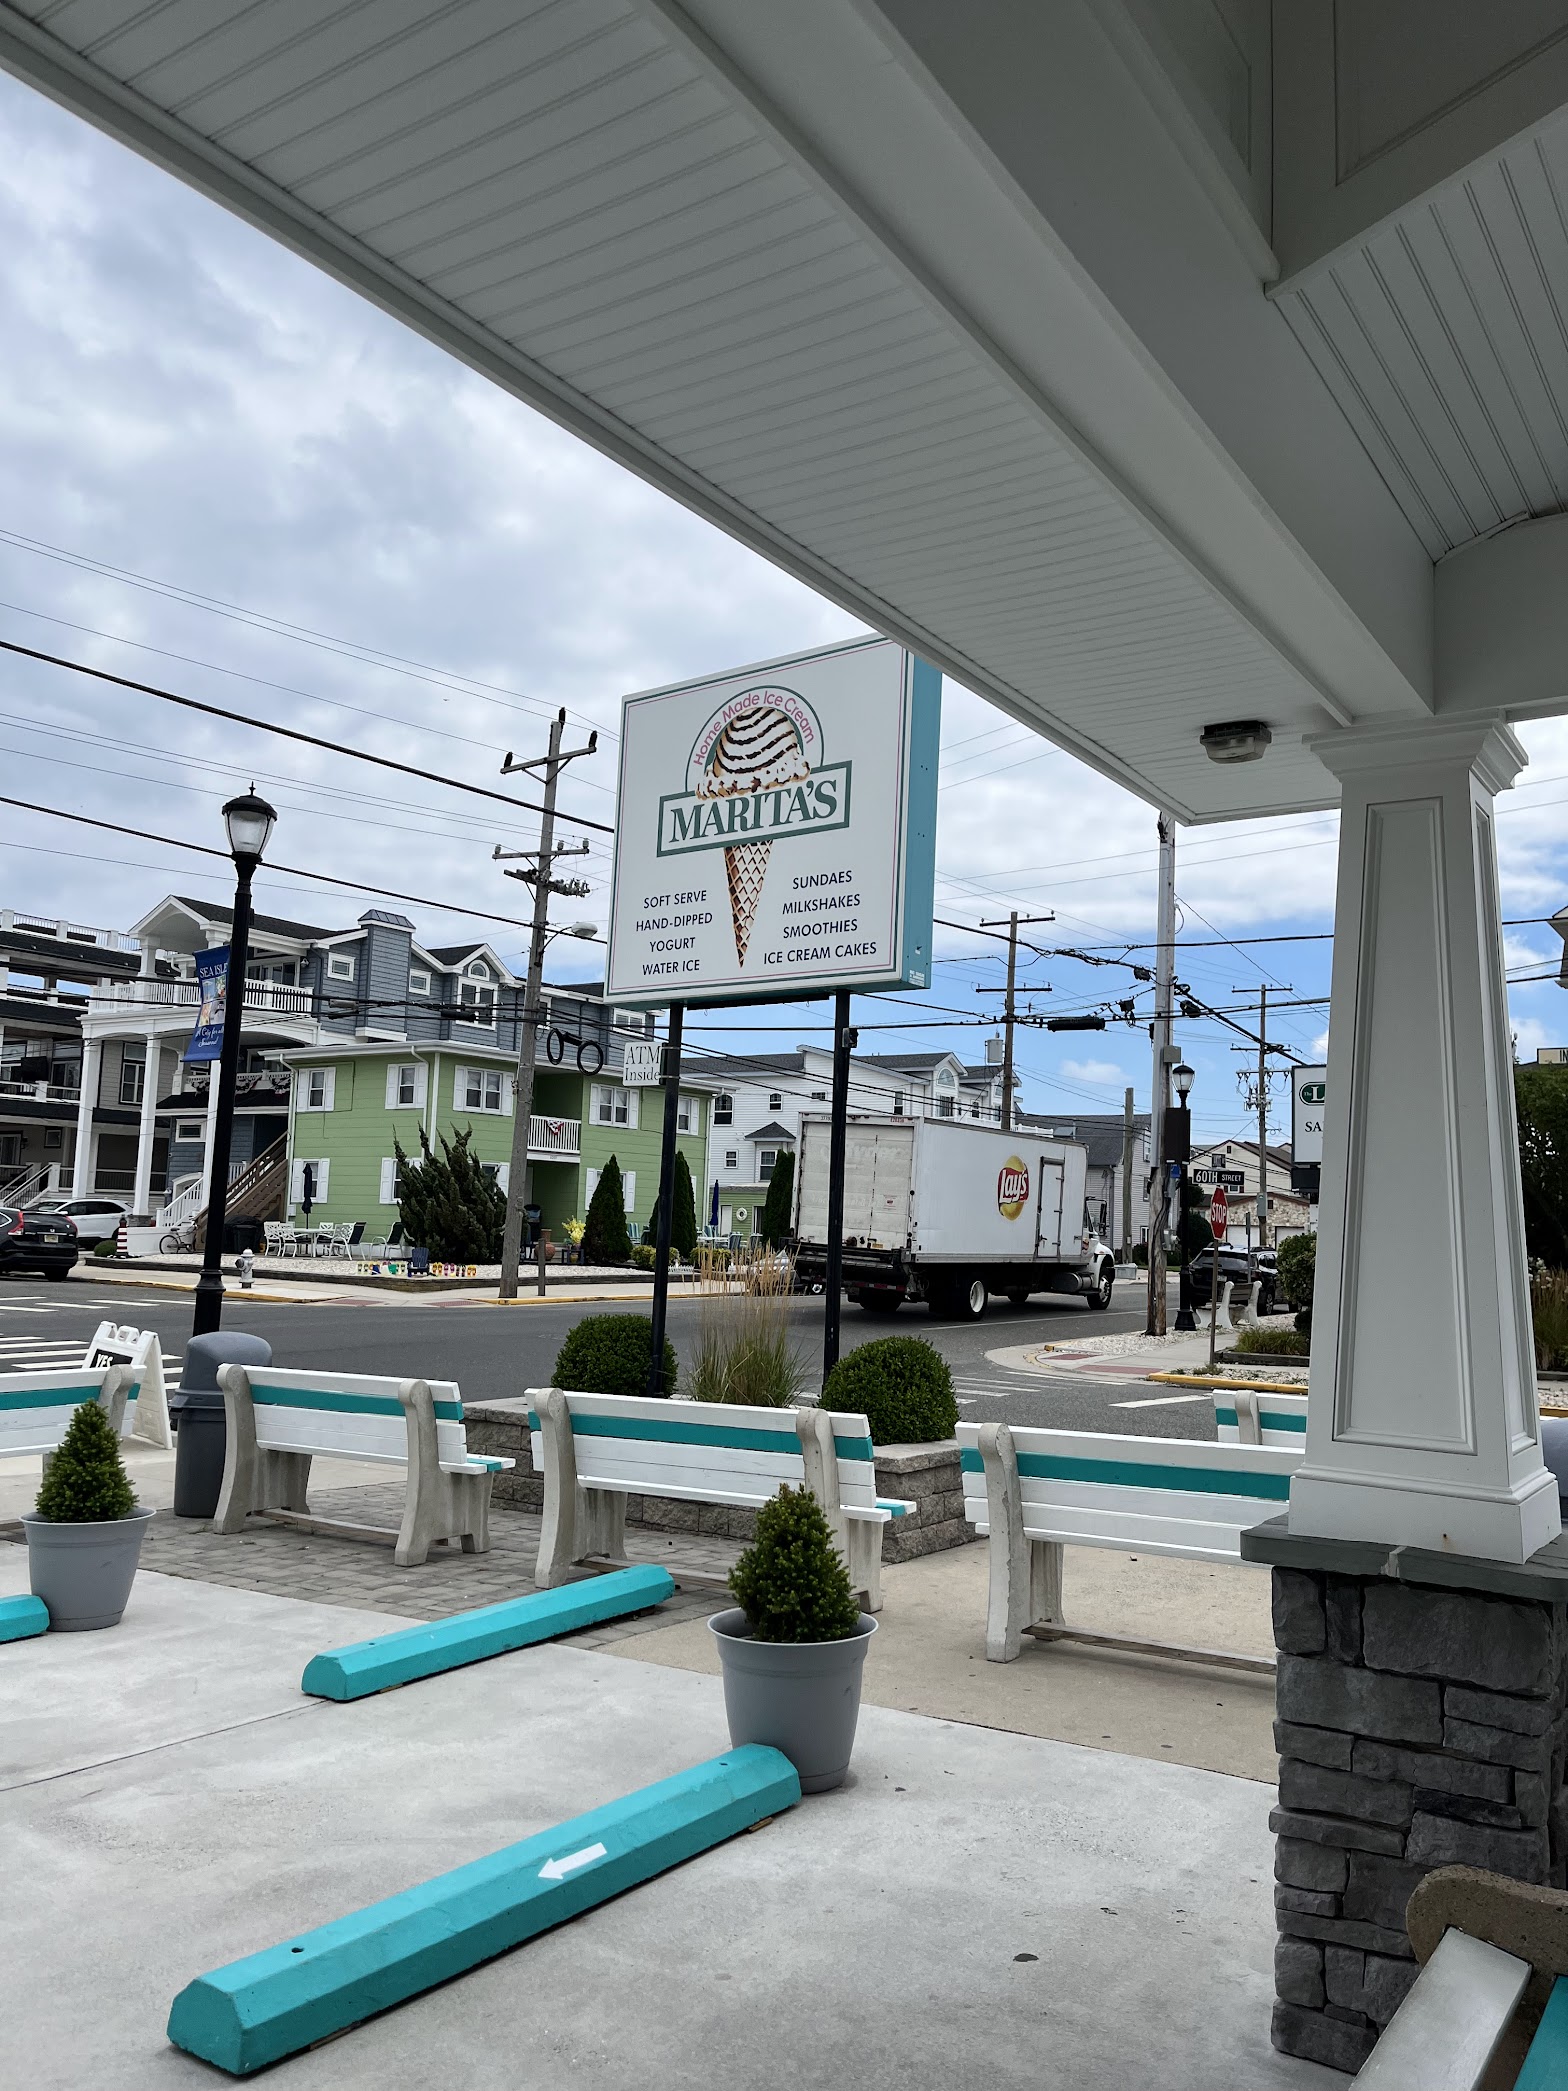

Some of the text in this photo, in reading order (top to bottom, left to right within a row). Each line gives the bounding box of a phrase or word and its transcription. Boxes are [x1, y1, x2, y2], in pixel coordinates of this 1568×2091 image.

[693, 690, 815, 766] Home Made Ice Cream
[669, 779, 837, 843] MARITA'S
[792, 870, 853, 890] SUNDAES
[643, 889, 707, 909] SOFT SERVE
[782, 893, 861, 915] MILKSHAKES
[635, 912, 713, 932] HAND-DIPPED
[783, 918, 858, 939] SMOOTHIES
[649, 936, 696, 953] YOGURT
[763, 941, 877, 965] ICE CREAM CAKES
[200, 963, 228, 978] SEA ISLE
[642, 959, 700, 976] WATER ICE
[625, 1045, 661, 1065] ATM
[625, 1066, 660, 1081] Inside
[999, 1169, 1028, 1204] Lay's
[1195, 1170, 1242, 1183] 60TH STREET
[1211, 1202, 1227, 1224] STOP
